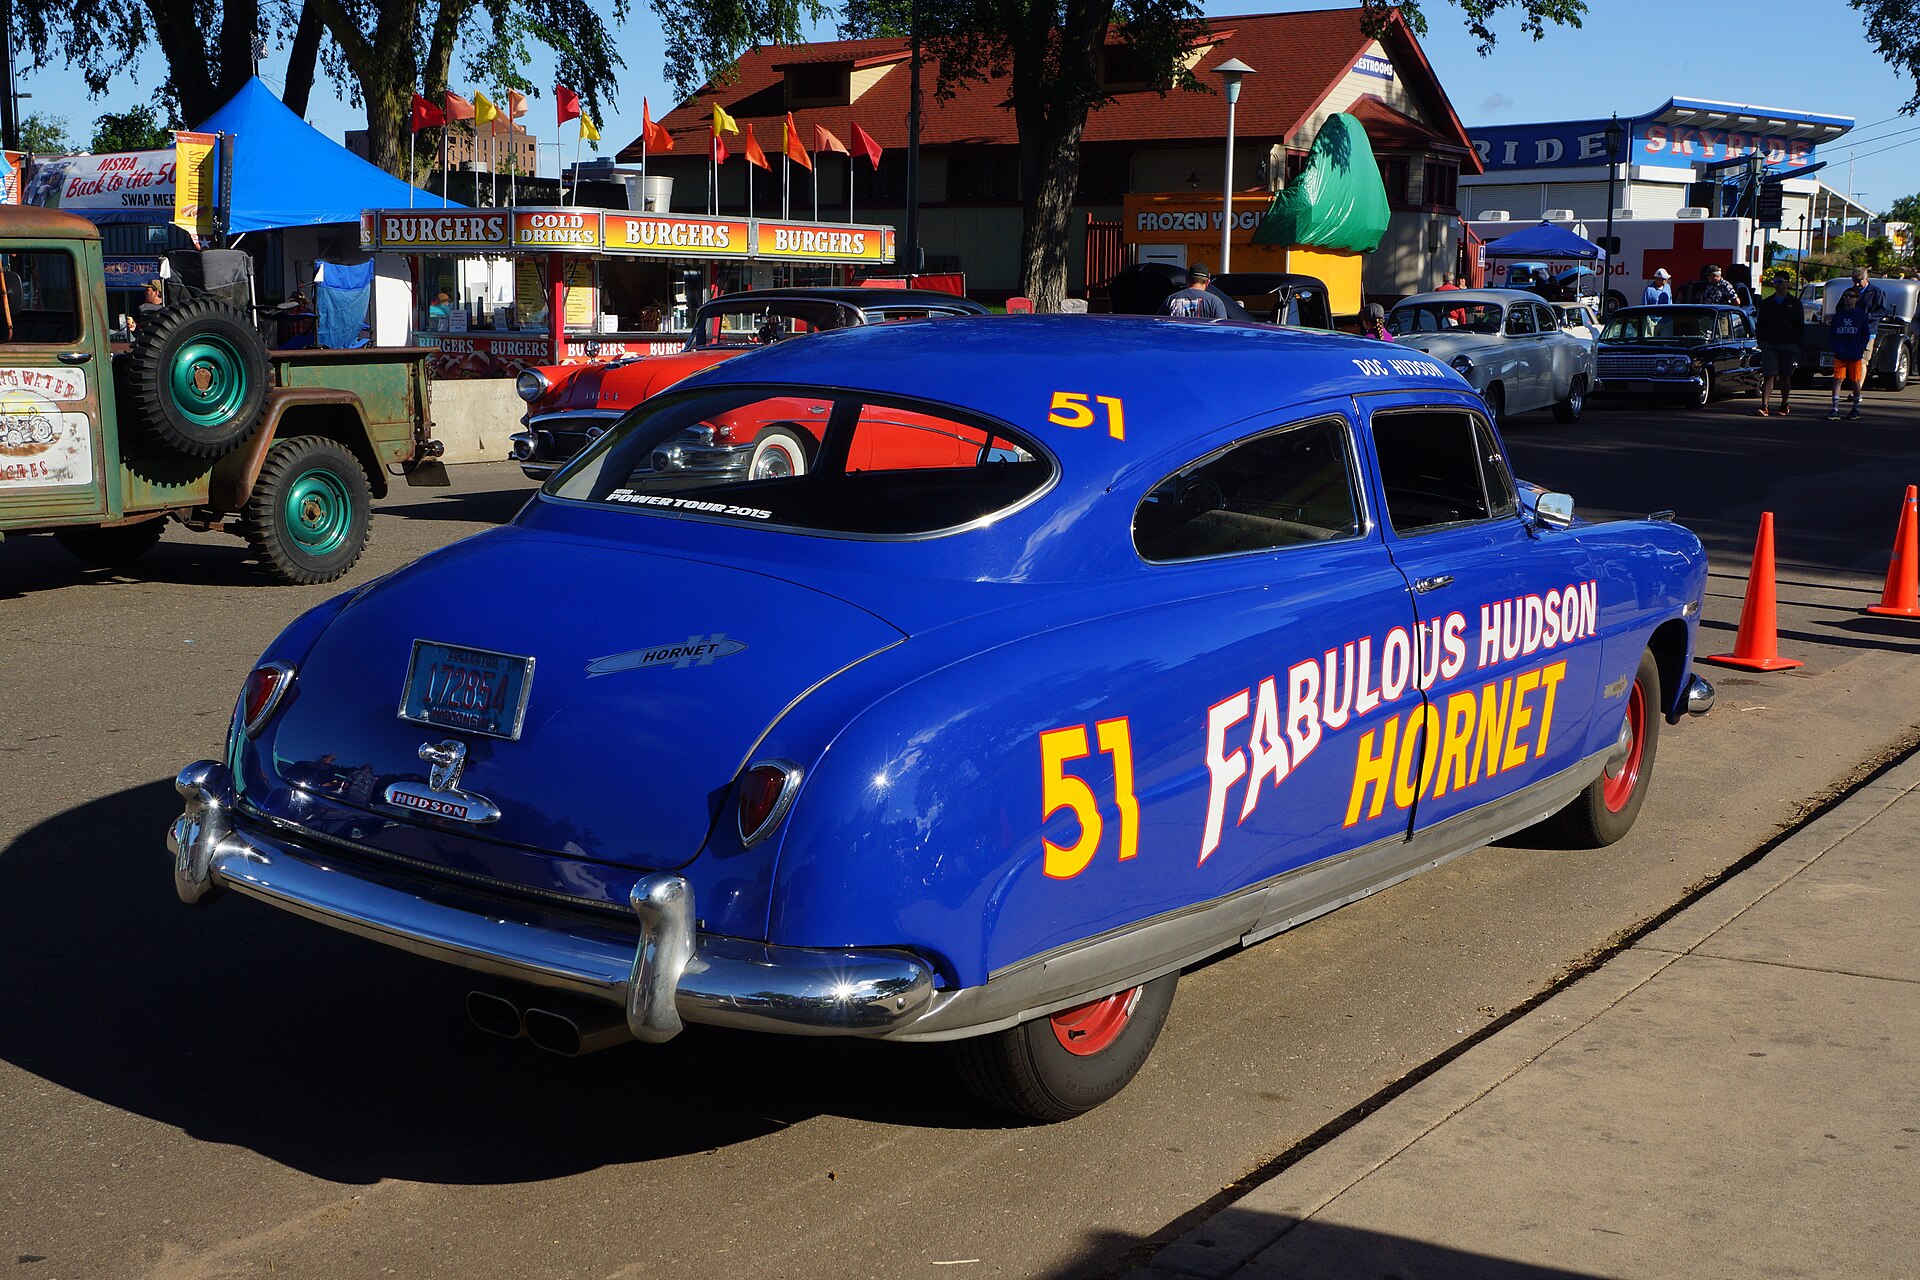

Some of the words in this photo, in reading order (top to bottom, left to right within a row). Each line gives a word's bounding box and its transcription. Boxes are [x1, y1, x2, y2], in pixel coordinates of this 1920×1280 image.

[1645, 126, 1810, 166] SKYRIDE
[97, 157, 138, 171] MSRA
[188, 150, 205, 177] DOGS
[65, 172, 107, 198] Back
[106, 171, 124, 191] to
[126, 168, 154, 189] the
[188, 179, 205, 201] HOT
[121, 194, 151, 206] SWAP
[385, 217, 504, 242] BURGERS
[530, 214, 584, 229] COLD
[1137, 212, 1208, 230] FROZEN
[520, 229, 595, 244] DRINKS
[625, 220, 730, 248] BURGERS
[775, 229, 865, 255] BURGERS
[419, 337, 475, 354] BURGERS
[490, 341, 549, 358] BURGERS
[567, 342, 626, 358] BUERS
[1352, 359, 1389, 376] DOC
[1386, 359, 1445, 378] HUDSON
[1047, 390, 1126, 442] 51
[0, 460, 49, 480] CRES
[605, 493, 674, 507] POWER
[672, 498, 729, 513] TOUR
[726, 505, 773, 520] 2015
[642, 643, 720, 663] HORNET
[423, 661, 511, 716] 172854
[1198, 609, 1470, 869] FABULOUS
[1476, 579, 1599, 670] HUDSON
[1343, 660, 1569, 830] HORNET
[393, 793, 468, 819] HUDSON
[1039, 715, 1140, 880] 51
